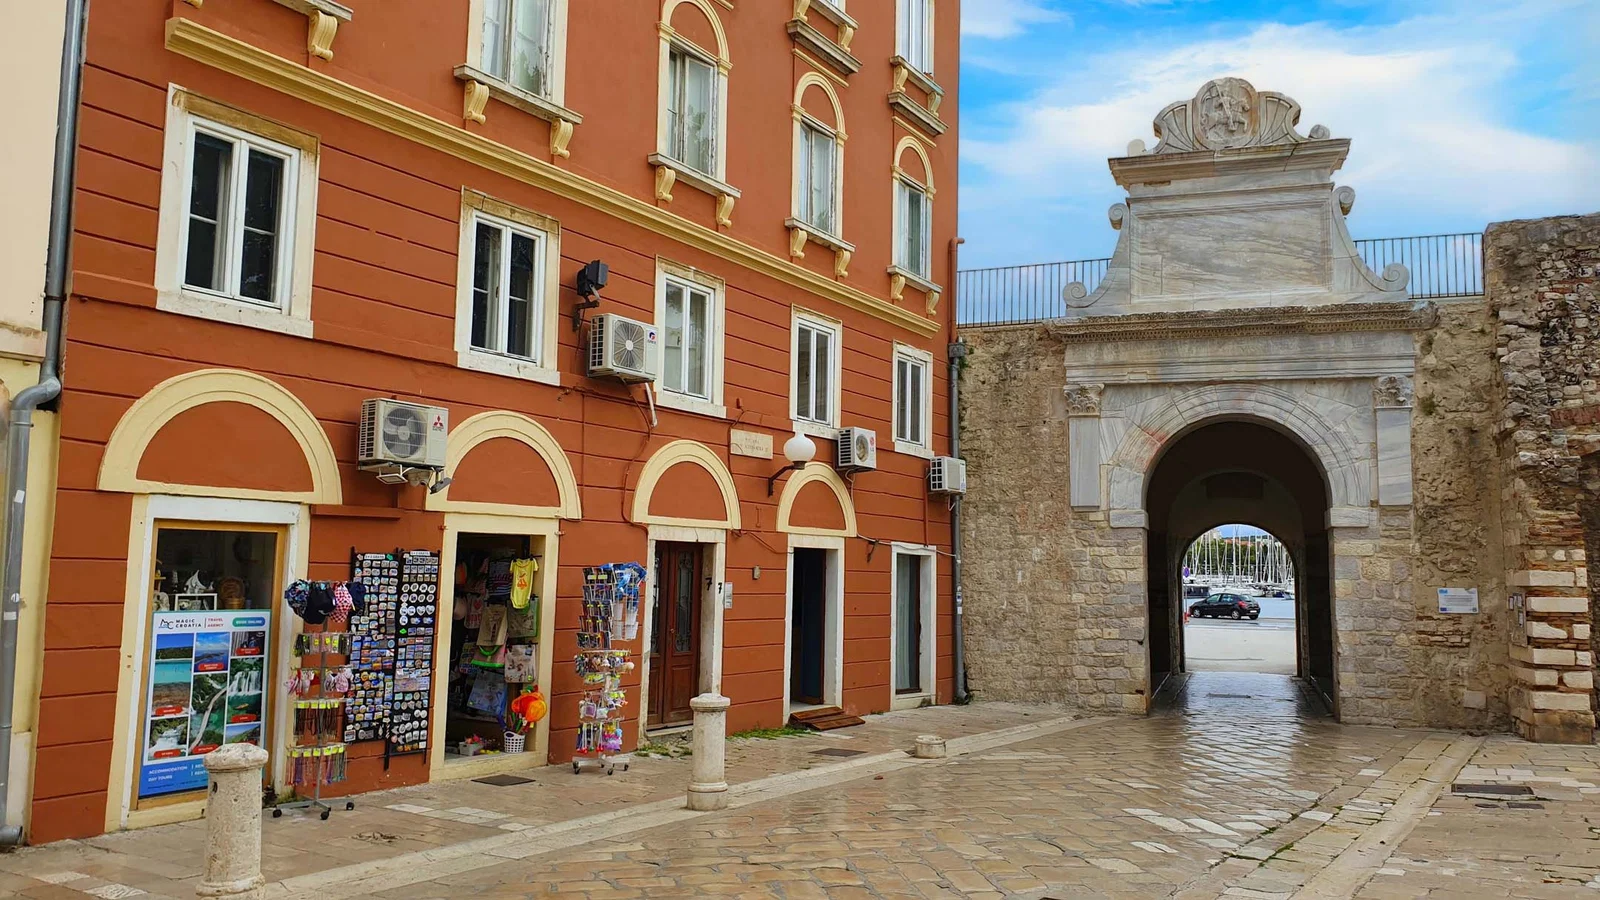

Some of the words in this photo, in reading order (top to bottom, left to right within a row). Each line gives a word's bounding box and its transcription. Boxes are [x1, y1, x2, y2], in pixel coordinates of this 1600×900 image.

[705, 577, 712, 591] 7
[718, 582, 722, 594] 7
[148, 766, 187, 774] ACCOMMODATION
